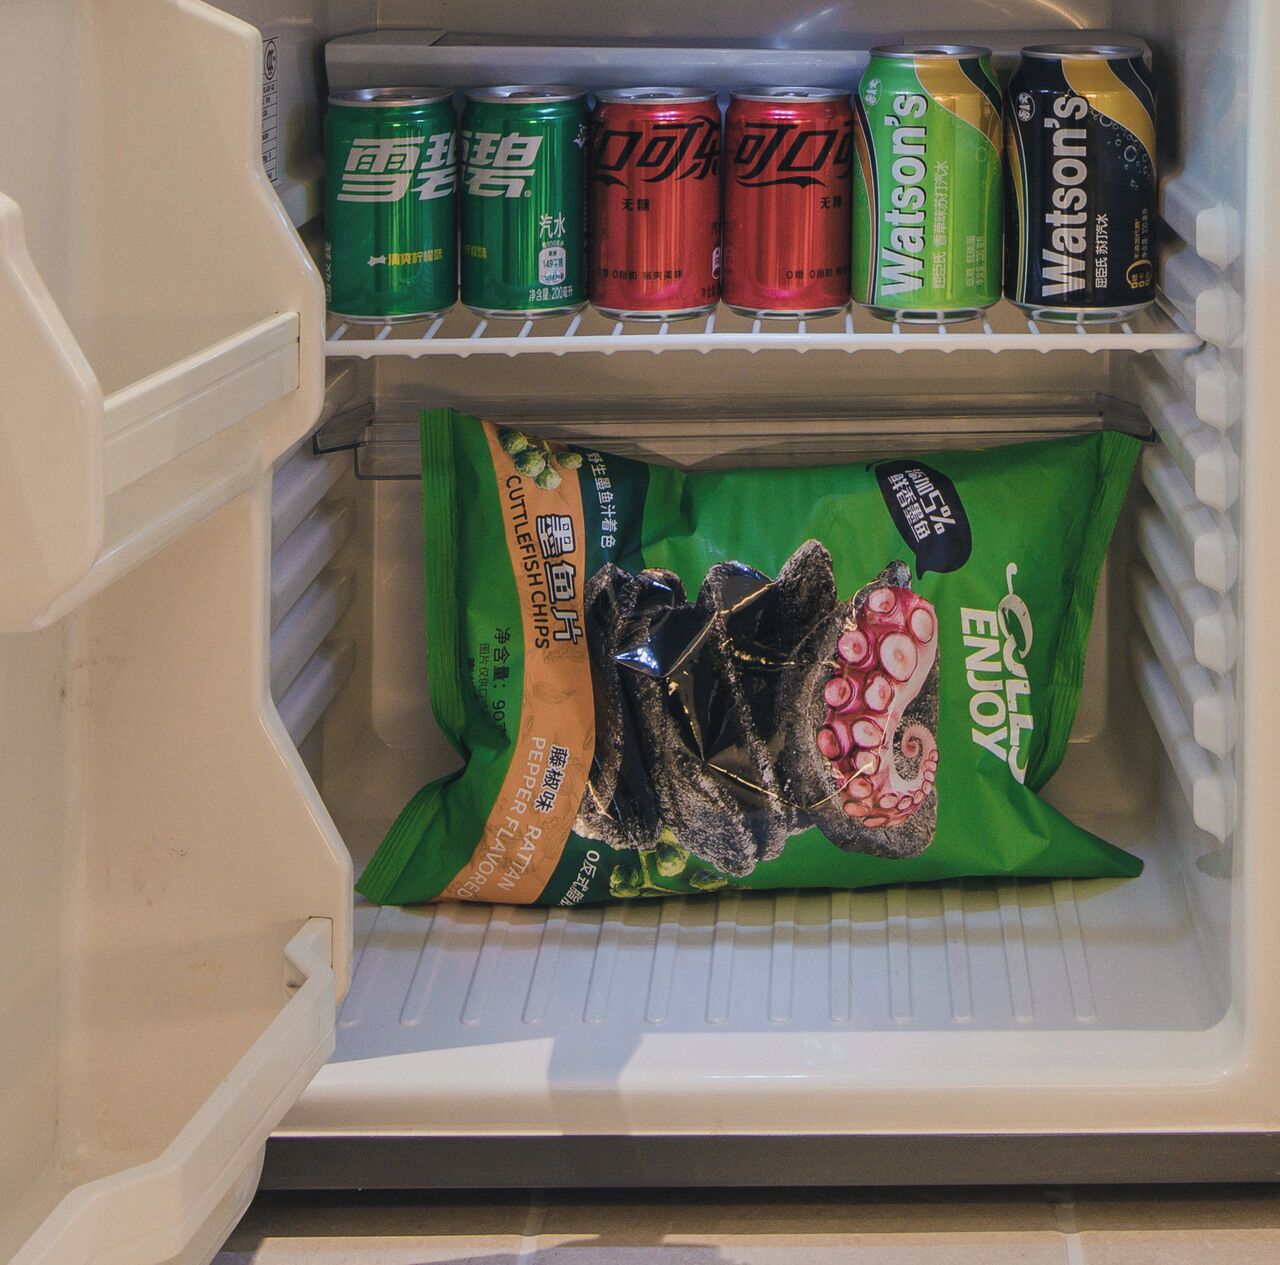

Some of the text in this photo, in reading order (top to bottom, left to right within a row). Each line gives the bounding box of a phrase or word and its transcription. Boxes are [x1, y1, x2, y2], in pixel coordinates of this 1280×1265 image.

[462, 131, 543, 198] 碧
[539, 212, 566, 238] 汽水
[881, 93, 928, 297] Watson's
[1042, 95, 1089, 297] Watson's
[1095, 213, 1109, 288] 屈臣氏 苏打汽水
[506, 475, 549, 649] CUTTLEFISH CHIPS
[586, 452, 618, 549] 野生墨鱼汁着色
[888, 474, 931, 543] 鲜香墨鱼
[536, 514, 583, 644] 墨鱼片
[960, 607, 1008, 762] ENJOY
[457, 737, 547, 897] PEPPER FLAVORED
[497, 744, 569, 892] 藤椒味 RATTAN
